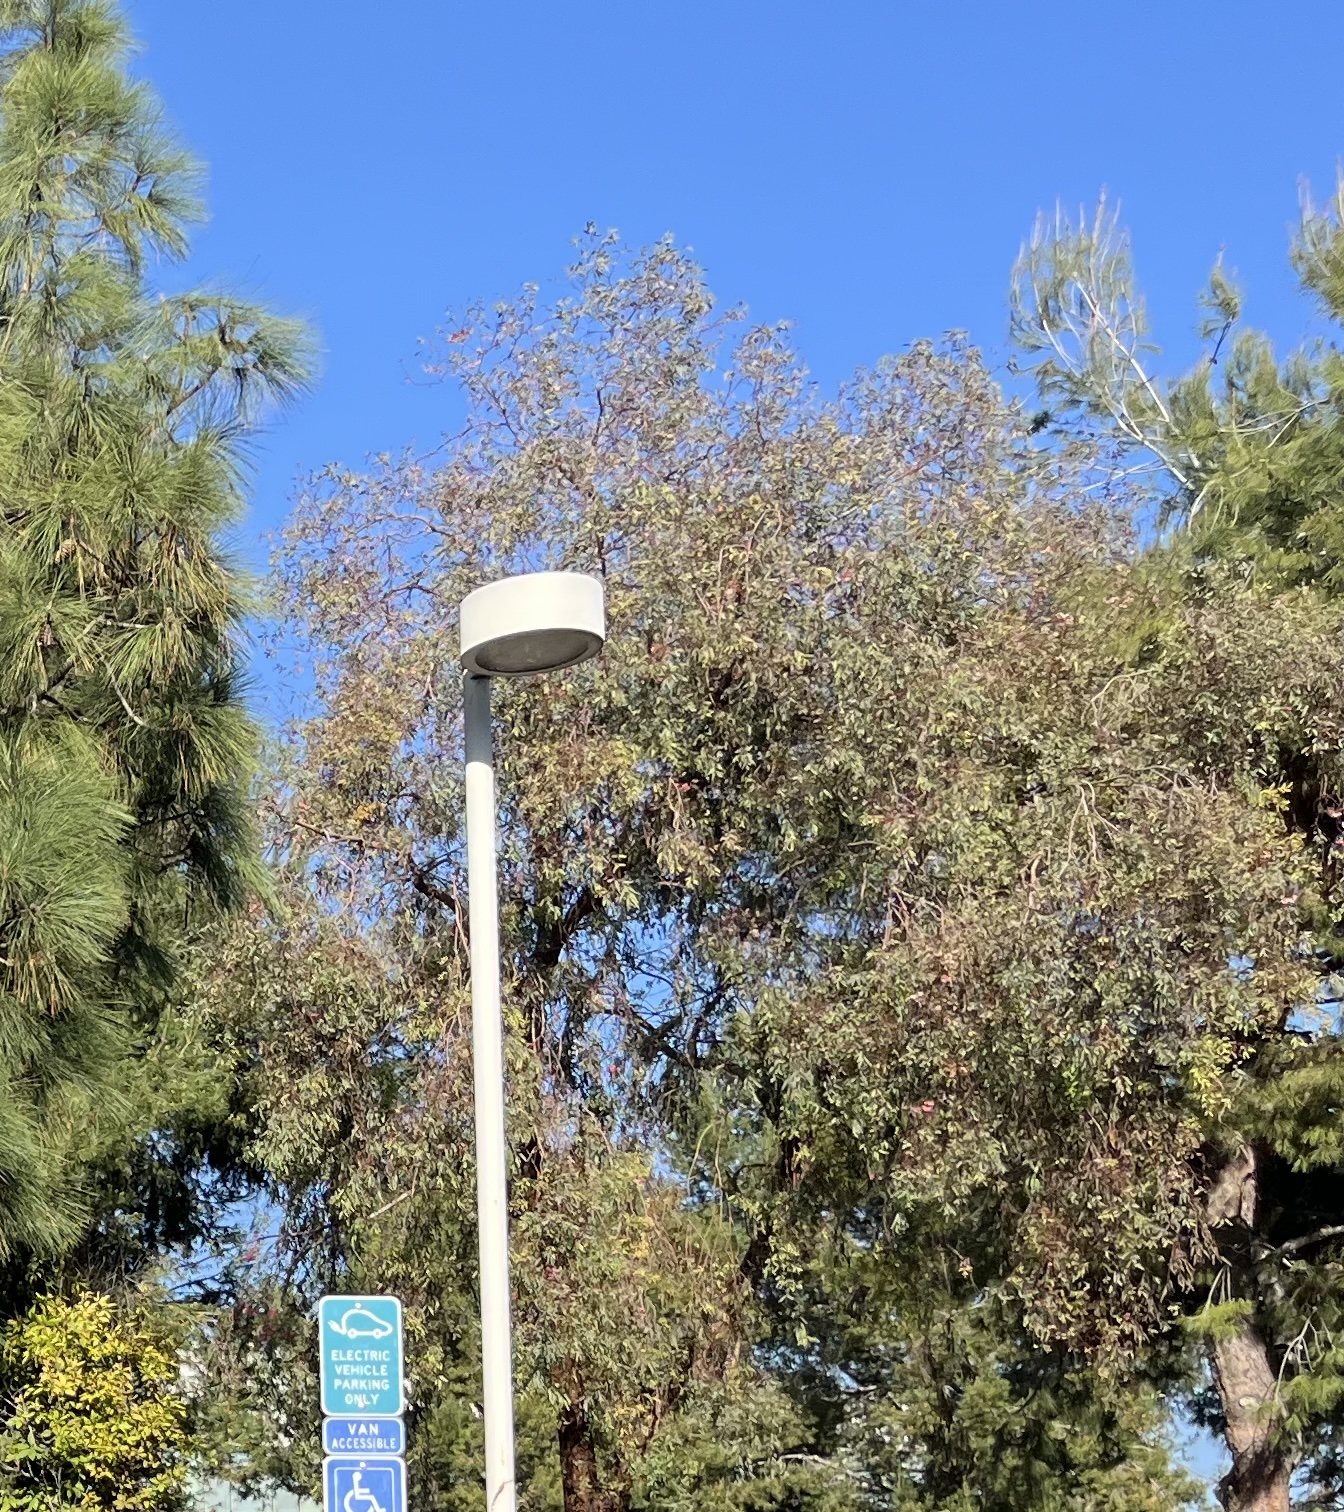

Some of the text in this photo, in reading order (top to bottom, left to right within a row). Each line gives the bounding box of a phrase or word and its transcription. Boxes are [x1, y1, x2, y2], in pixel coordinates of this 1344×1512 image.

[330, 1349, 390, 1361] ELECTRIC
[334, 1364, 388, 1376] VEHICLE
[333, 1379, 390, 1391] PARKING
[344, 1393, 379, 1405] ONLY
[347, 1423, 379, 1436] VAN
[331, 1437, 396, 1449] ACCESSIBLE
